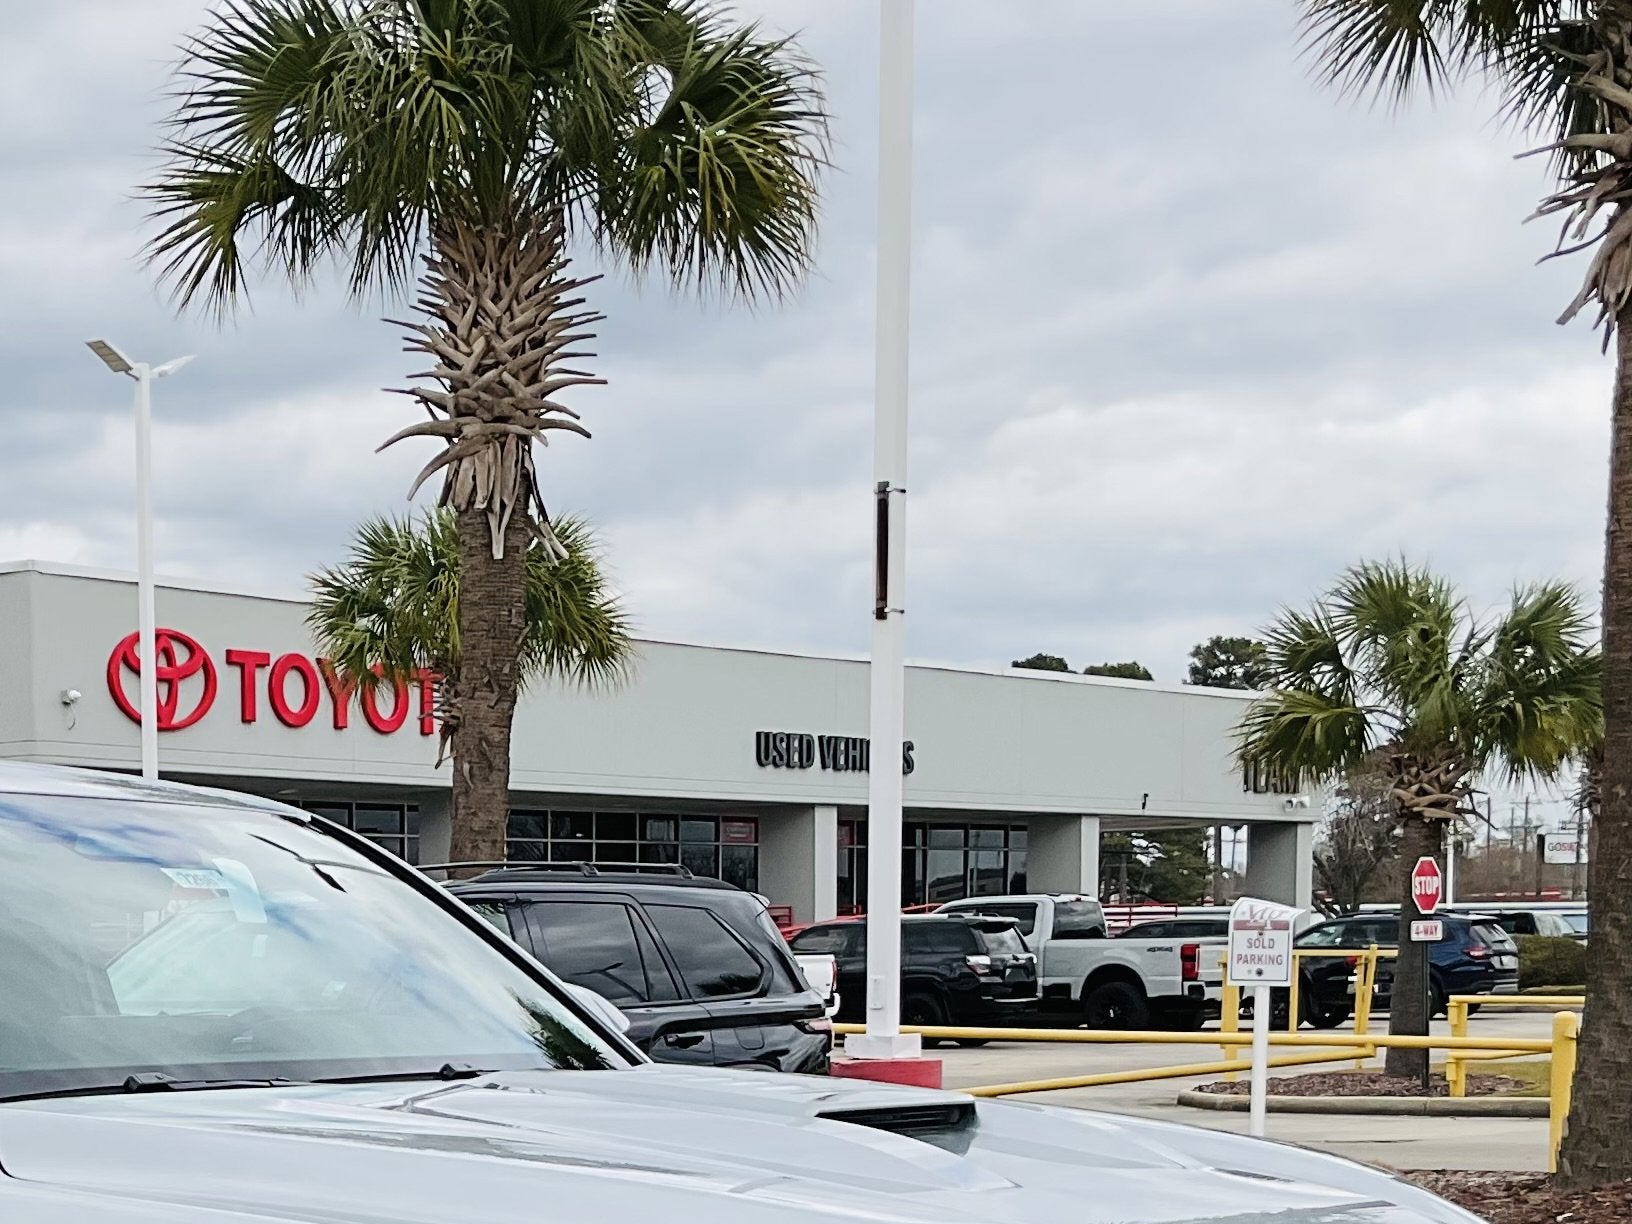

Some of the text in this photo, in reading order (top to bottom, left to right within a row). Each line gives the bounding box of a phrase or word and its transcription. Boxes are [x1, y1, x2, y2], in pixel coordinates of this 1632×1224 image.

[226, 649, 446, 735] TOYOT
[756, 731, 915, 775] USED VEHIS
[1414, 876, 1439, 895] STOP
[1414, 924, 1438, 936] 4-WAY
[1246, 938, 1275, 949] SOLD
[1236, 953, 1283, 966] PARKING
